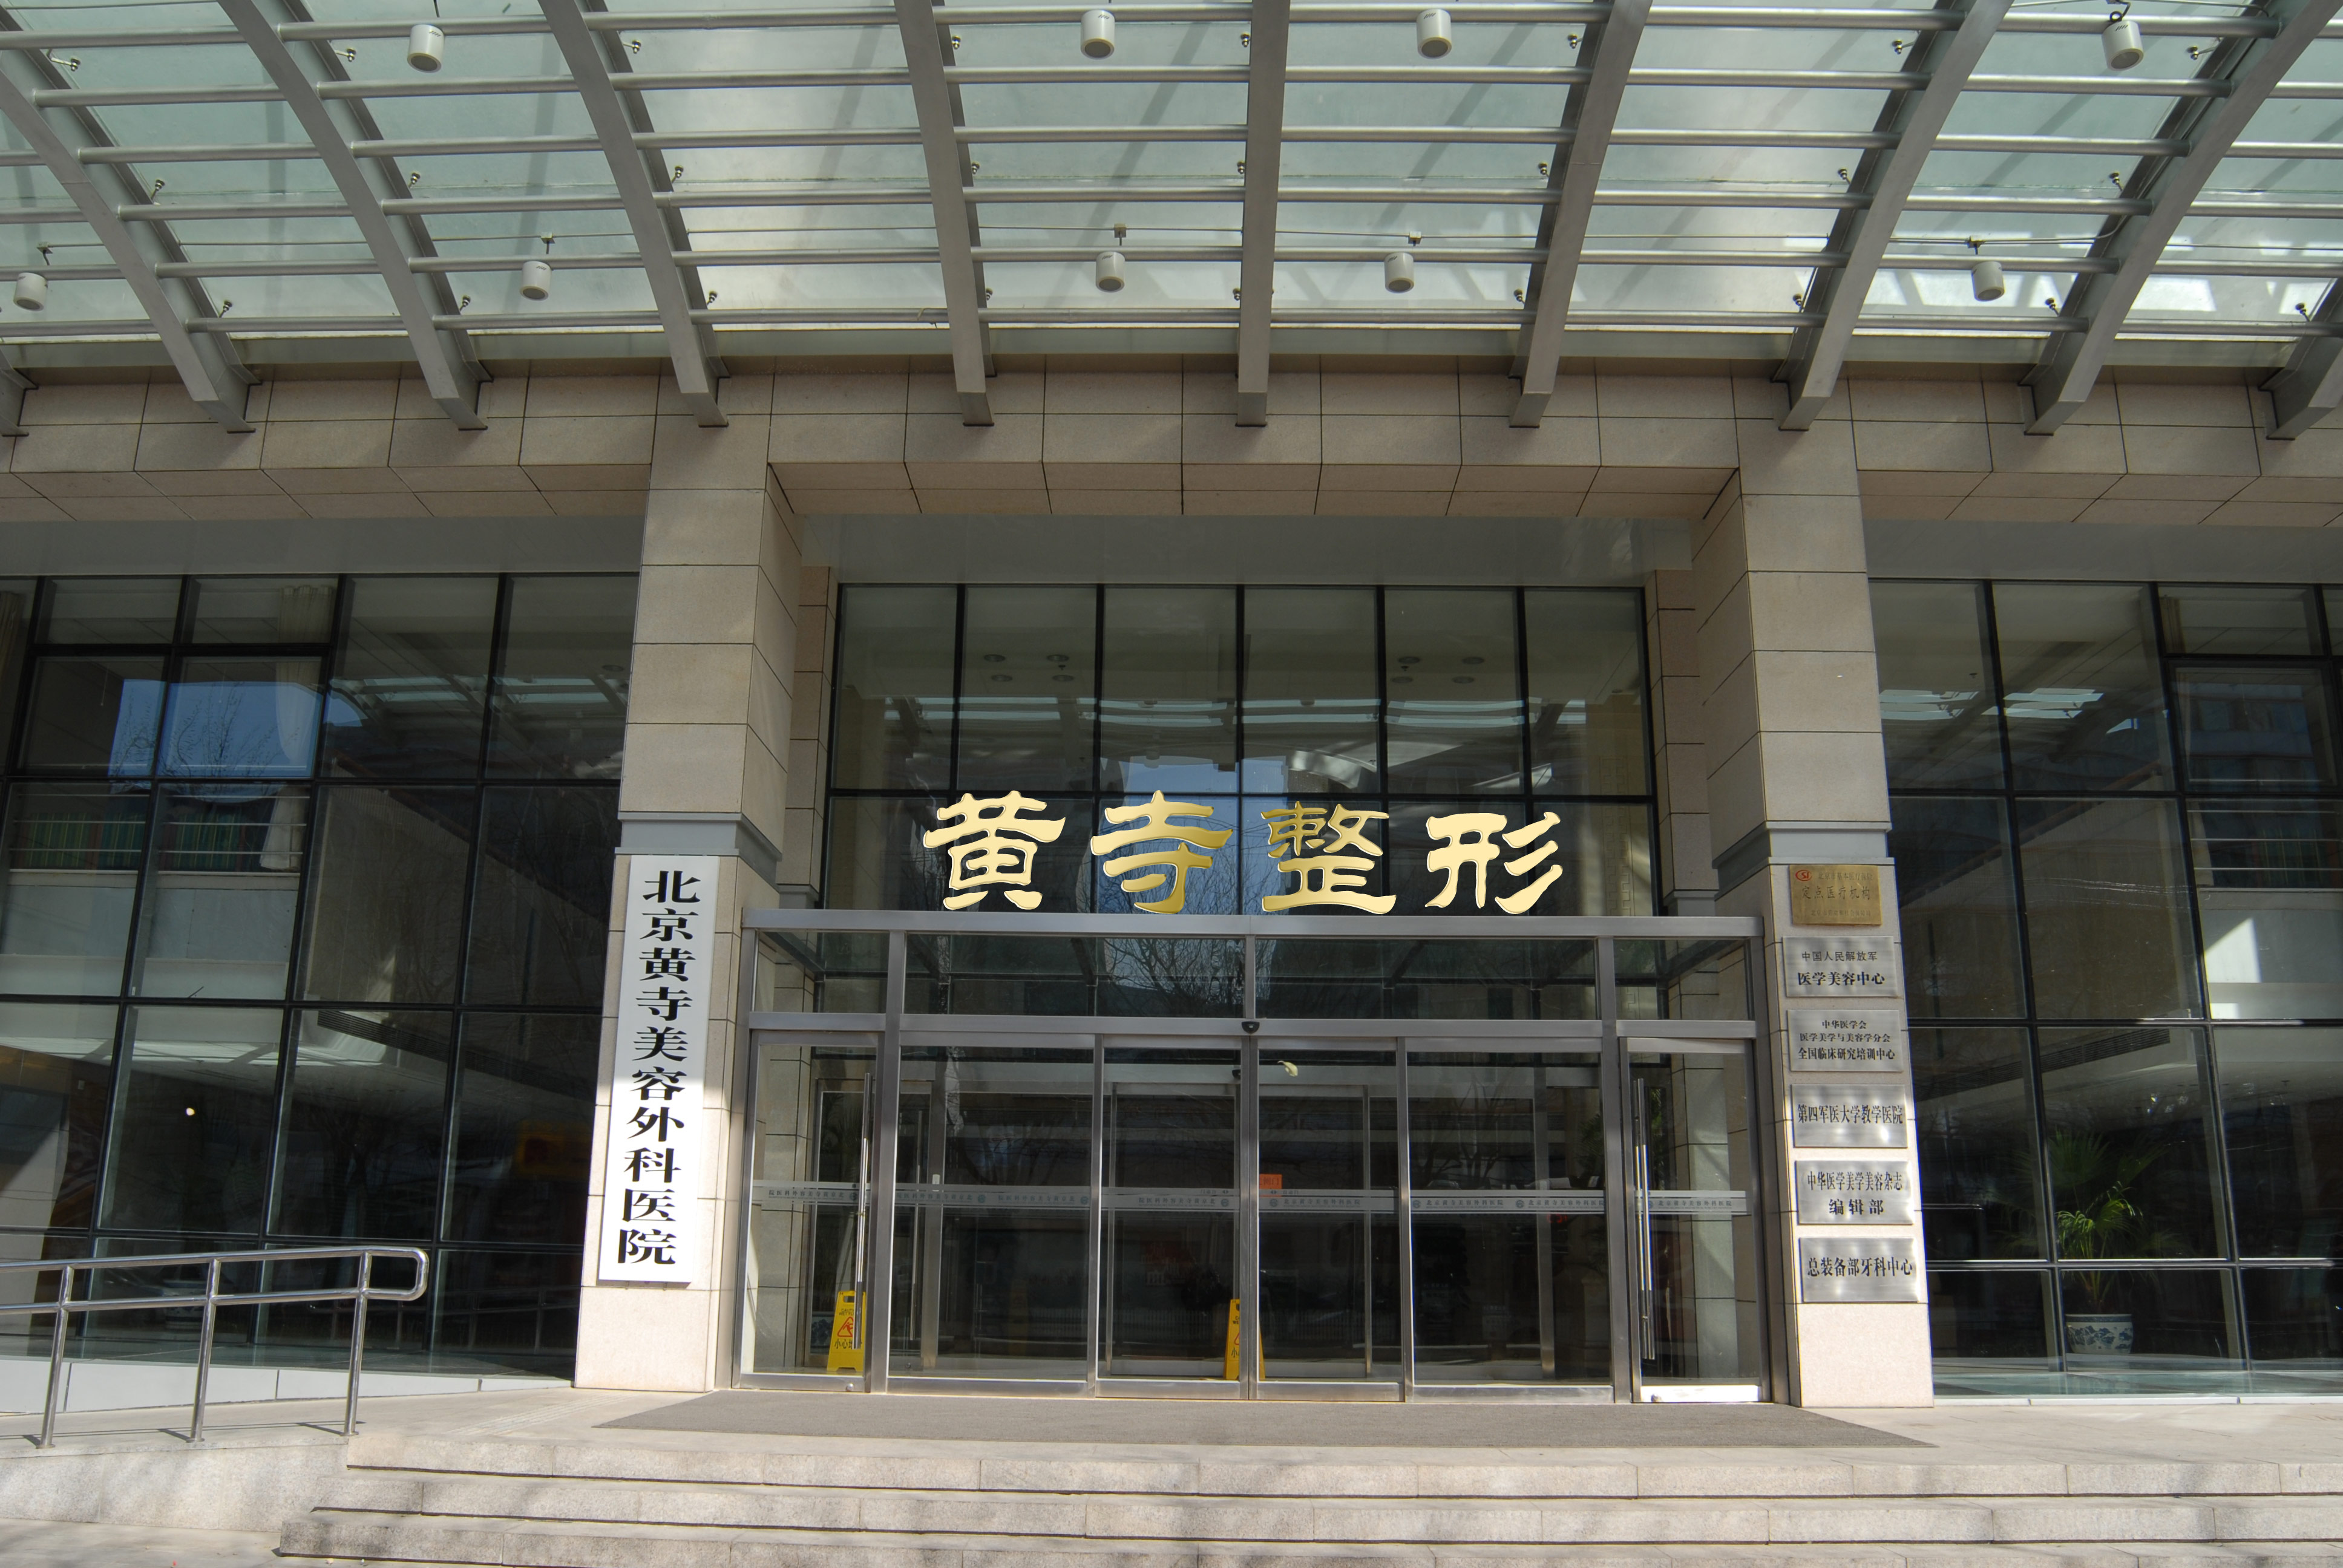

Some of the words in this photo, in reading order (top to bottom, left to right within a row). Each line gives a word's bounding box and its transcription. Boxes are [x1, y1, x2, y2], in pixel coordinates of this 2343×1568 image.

[923, 790, 1562, 914] 黄寺整形
[1801, 885, 1870, 900] 定点医疗机构
[1801, 951, 1878, 962] 中国人民解放军
[1798, 972, 1885, 986] 医学美容中心
[1822, 1020, 1867, 1029] 中华医学会
[1800, 1033, 1891, 1042] 医学美学与美容学分会
[1798, 1047, 1895, 1060] 全国临床研究培训中心
[617, 870, 701, 1264] 北京黄寺美容外科医院
[1797, 1104, 1903, 1125] 第四军医大学教学医院
[1807, 1171, 1902, 1191] 中华医学美学美容杂志
[1829, 1199, 1884, 1215] 编辑部
[1807, 1257, 1913, 1277] 总装备部牙科中心
[834, 1338, 862, 1350] 小心地
